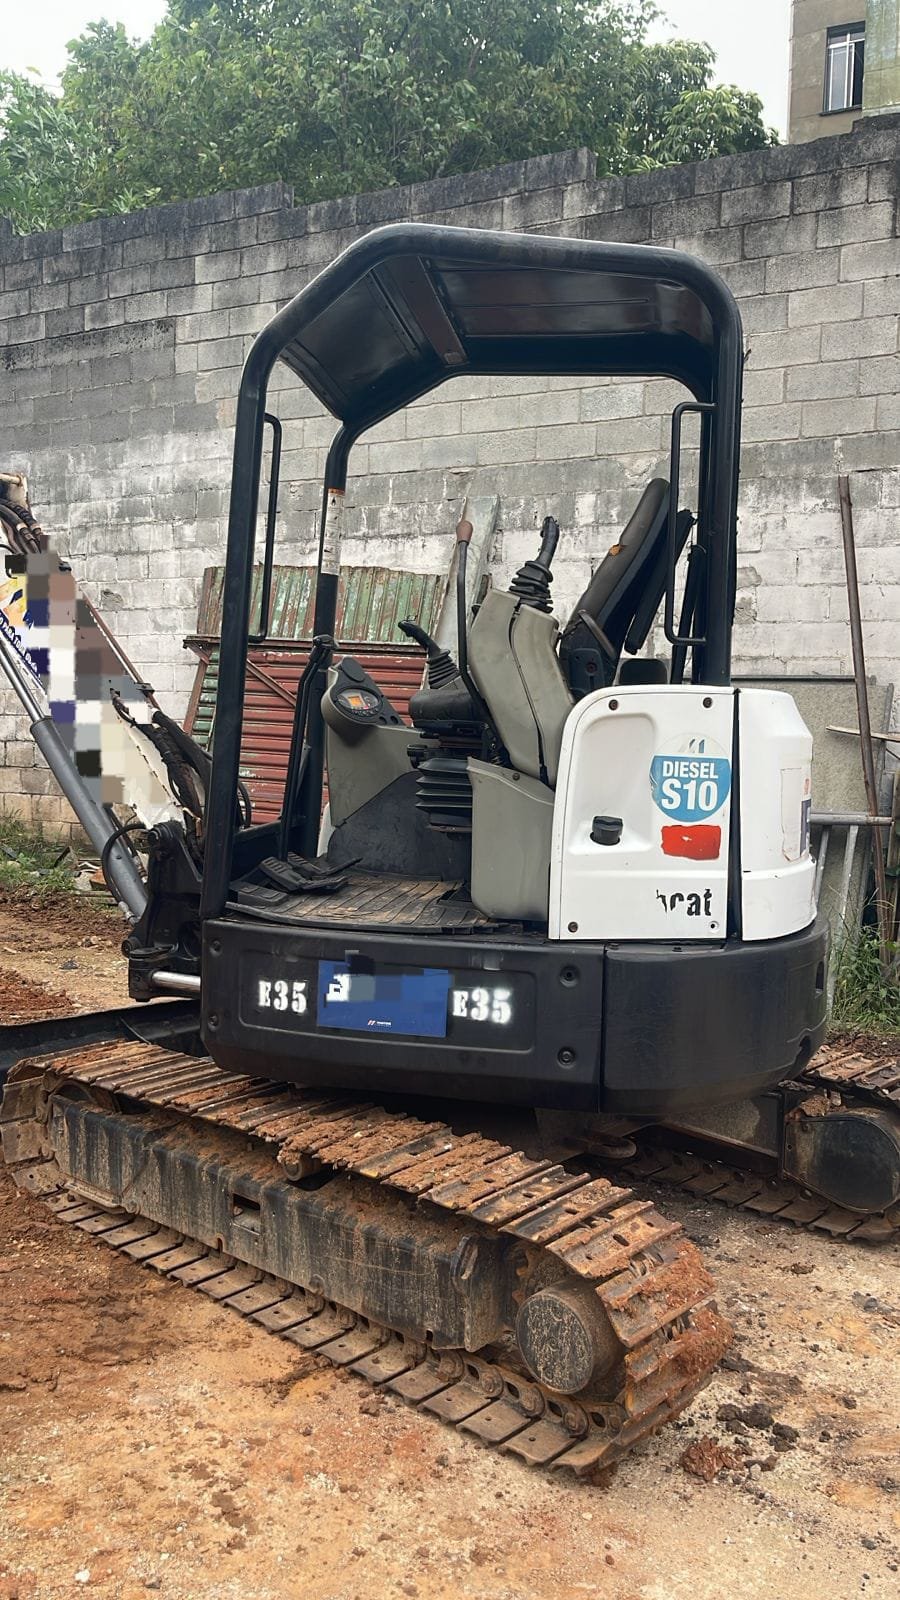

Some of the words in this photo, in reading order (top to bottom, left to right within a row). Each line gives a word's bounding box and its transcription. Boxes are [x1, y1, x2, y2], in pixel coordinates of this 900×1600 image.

[663, 761, 718, 778] DIESEL
[661, 778, 718, 811] S10
[258, 980, 307, 1012] E35
[453, 988, 511, 1025] E35
